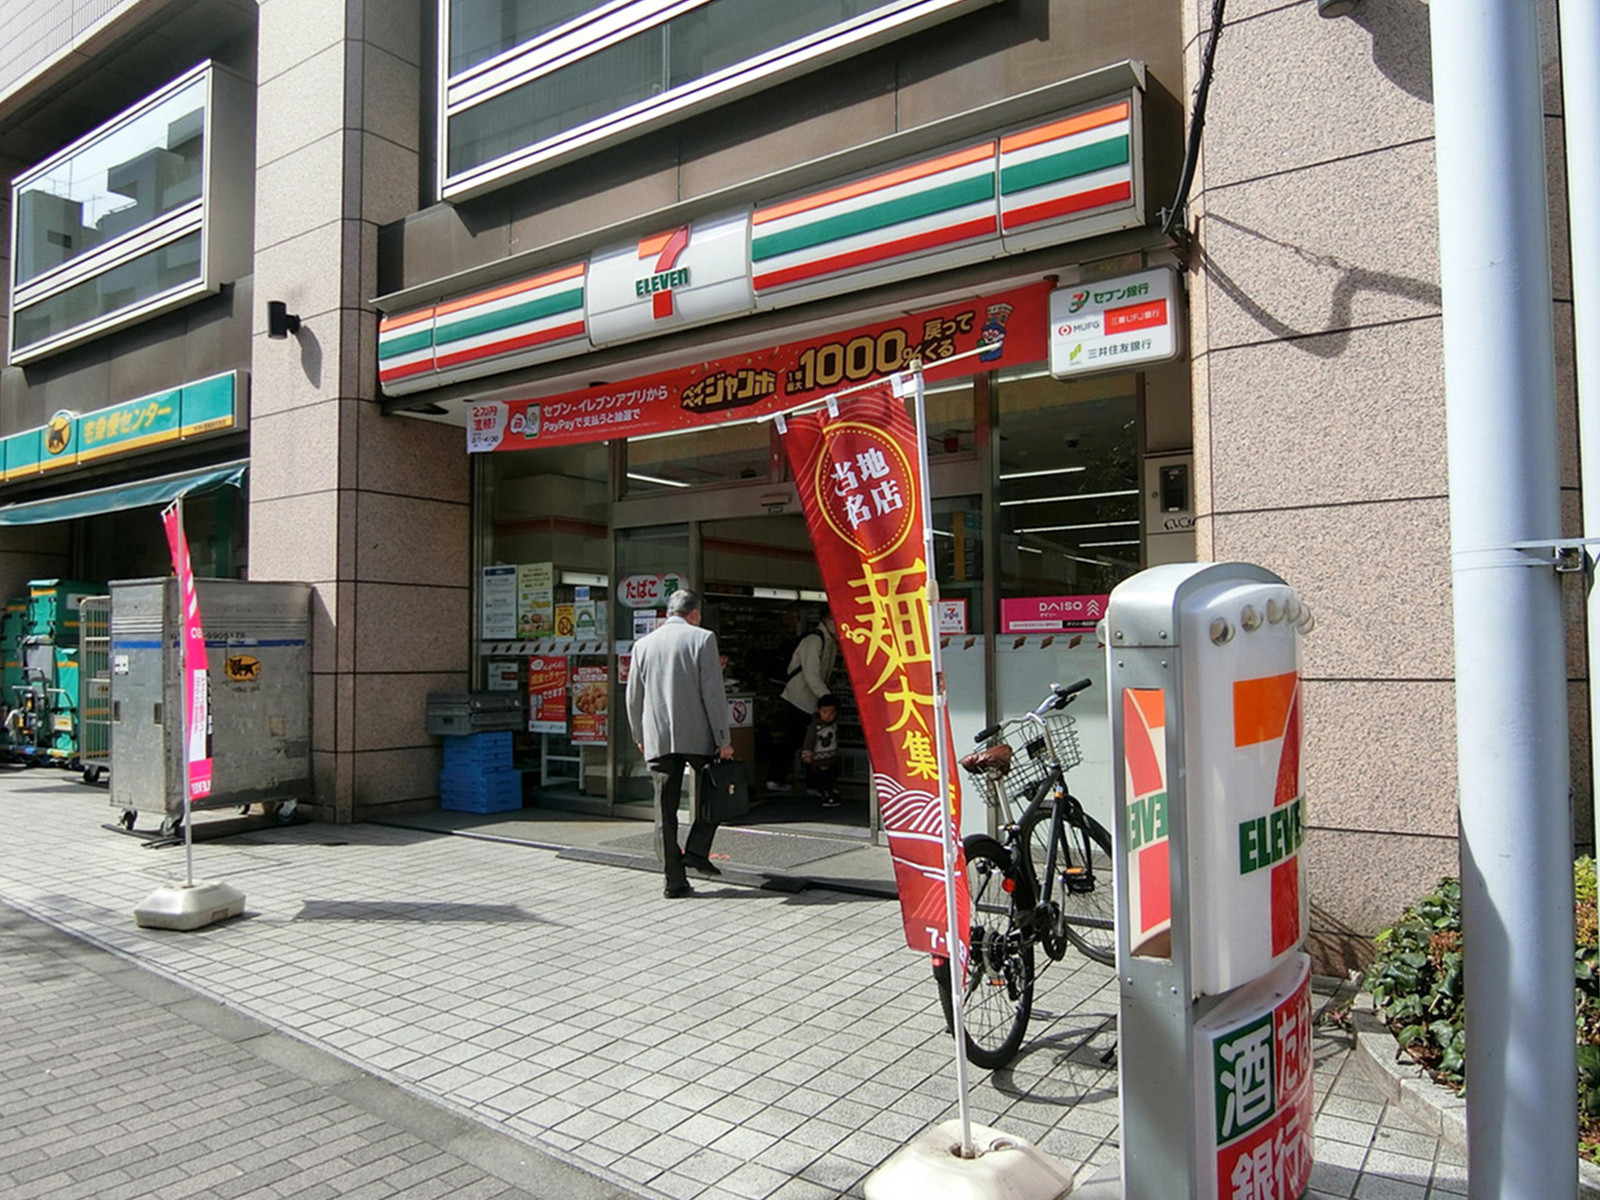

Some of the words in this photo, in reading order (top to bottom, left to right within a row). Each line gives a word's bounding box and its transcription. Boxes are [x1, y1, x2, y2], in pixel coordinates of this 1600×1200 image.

[1094, 282, 1149, 304] セブン銀行
[924, 313, 974, 341] 戻って
[1073, 321, 1100, 332] MUFG
[925, 340, 954, 360] くる
[1088, 339, 1152, 359] 三井住友銀行
[682, 382, 704, 398] ペイ
[705, 370, 776, 405] ジャンボ
[682, 395, 705, 408] ペイ
[830, 448, 890, 497] 当地
[843, 479, 904, 531] 名店
[626, 581, 658, 599] たばこ
[1039, 601, 1083, 612] DAISO
[1219, 1023, 1272, 1138] 酒
